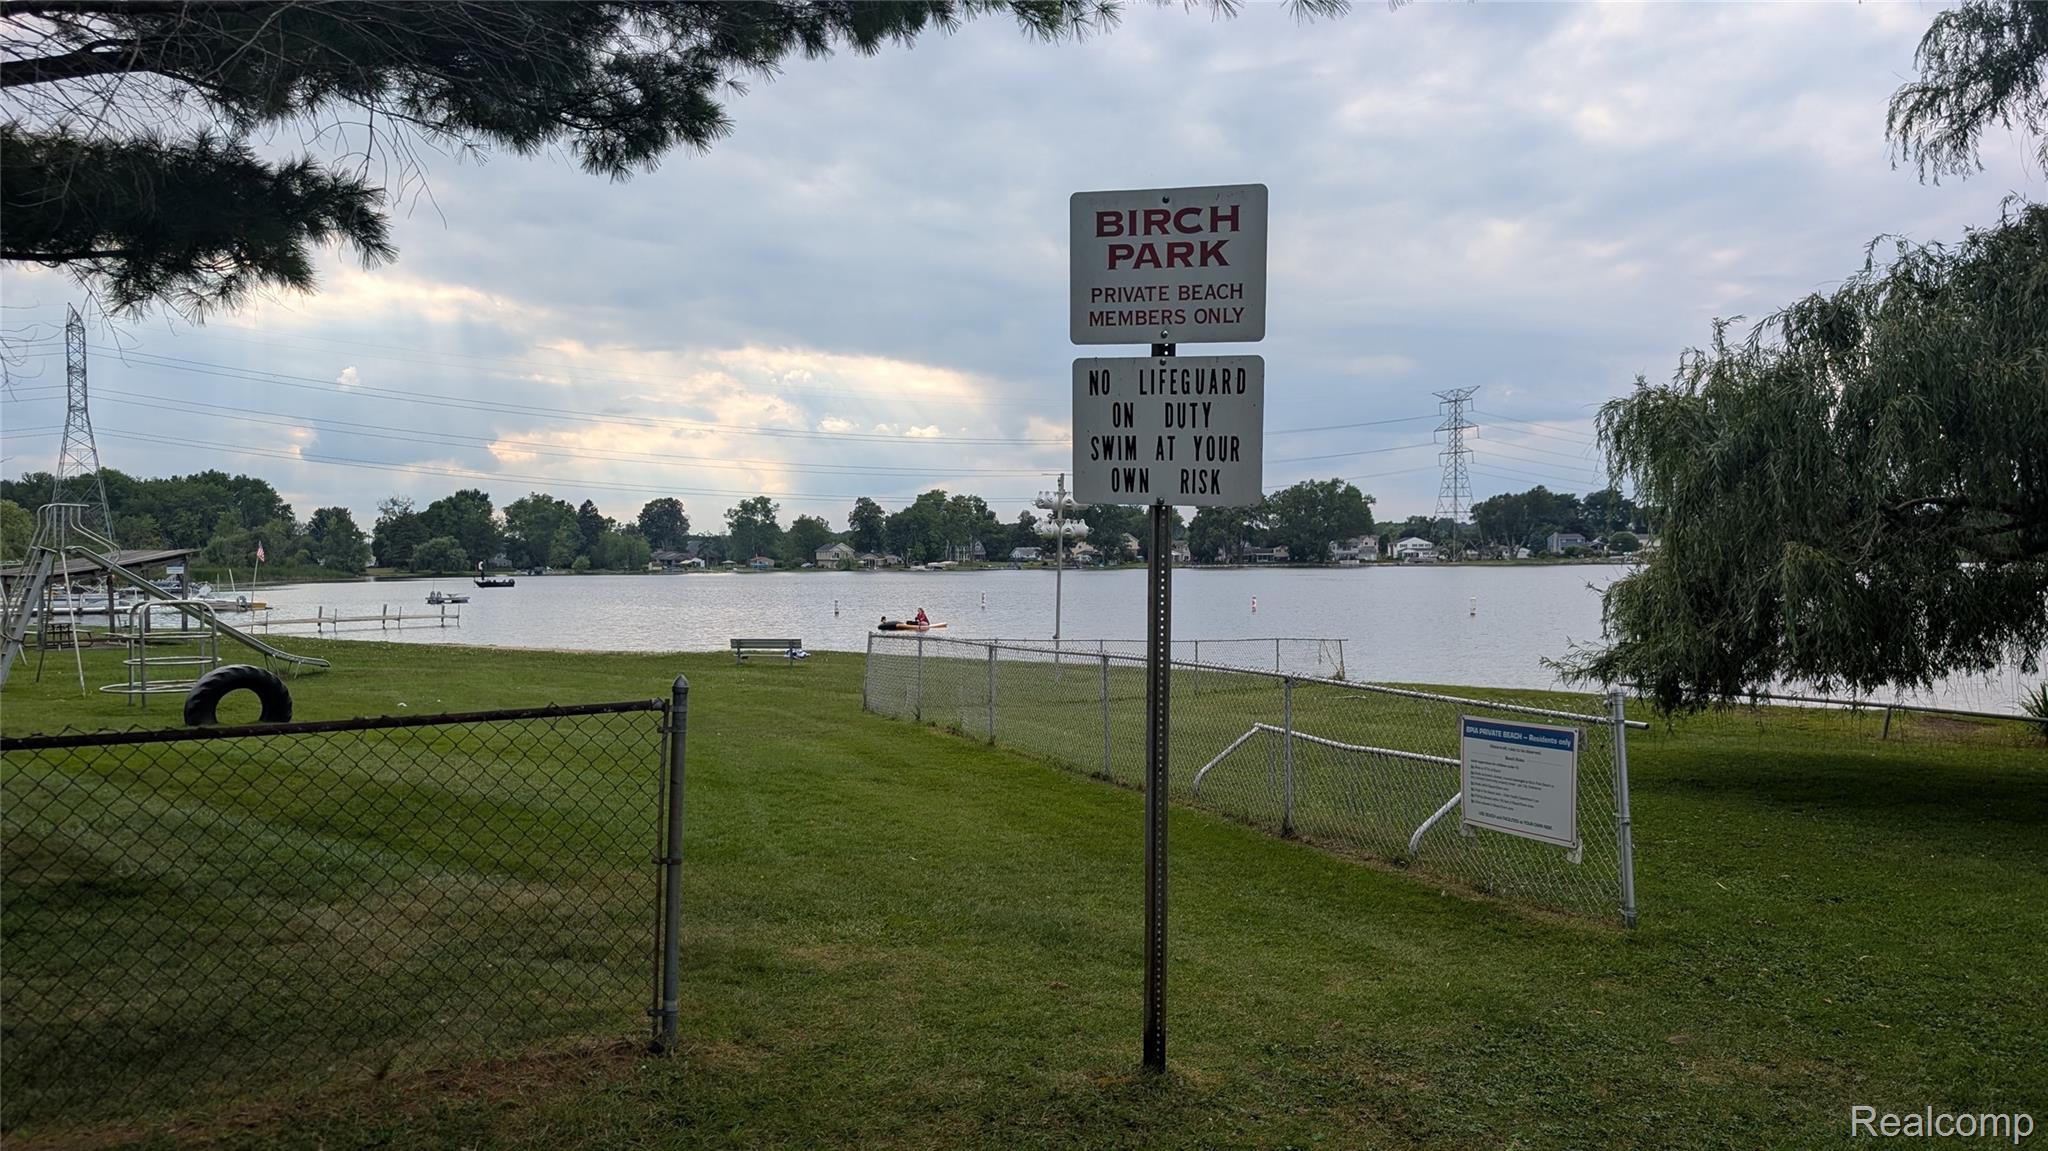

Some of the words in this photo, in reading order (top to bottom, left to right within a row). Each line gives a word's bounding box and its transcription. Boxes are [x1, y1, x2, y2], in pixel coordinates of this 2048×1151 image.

[1095, 204, 1240, 238] BIRCH
[1107, 239, 1230, 270] PARK
[1091, 285, 1170, 303] PRIVATE
[1178, 283, 1244, 300] BEACH
[1089, 308, 1186, 327] MEMBERS
[1194, 306, 1245, 324] ONLY
[1089, 369, 1111, 396] NO
[1139, 367, 1247, 396] LIFEGUARD
[1112, 401, 1134, 428] ON
[1164, 401, 1212, 429] DUTY
[1091, 435, 1137, 461] SWIM
[1155, 435, 1176, 461] AT
[1193, 435, 1240, 462] YOUR
[1111, 467, 1149, 493] OWN
[1180, 468, 1221, 495] RISK
[1479, 727, 1502, 737] PRIVATE
[1503, 730, 1523, 740] BEACH
[1529, 734, 1558, 745] Residents
[1558, 739, 1571, 748] only
